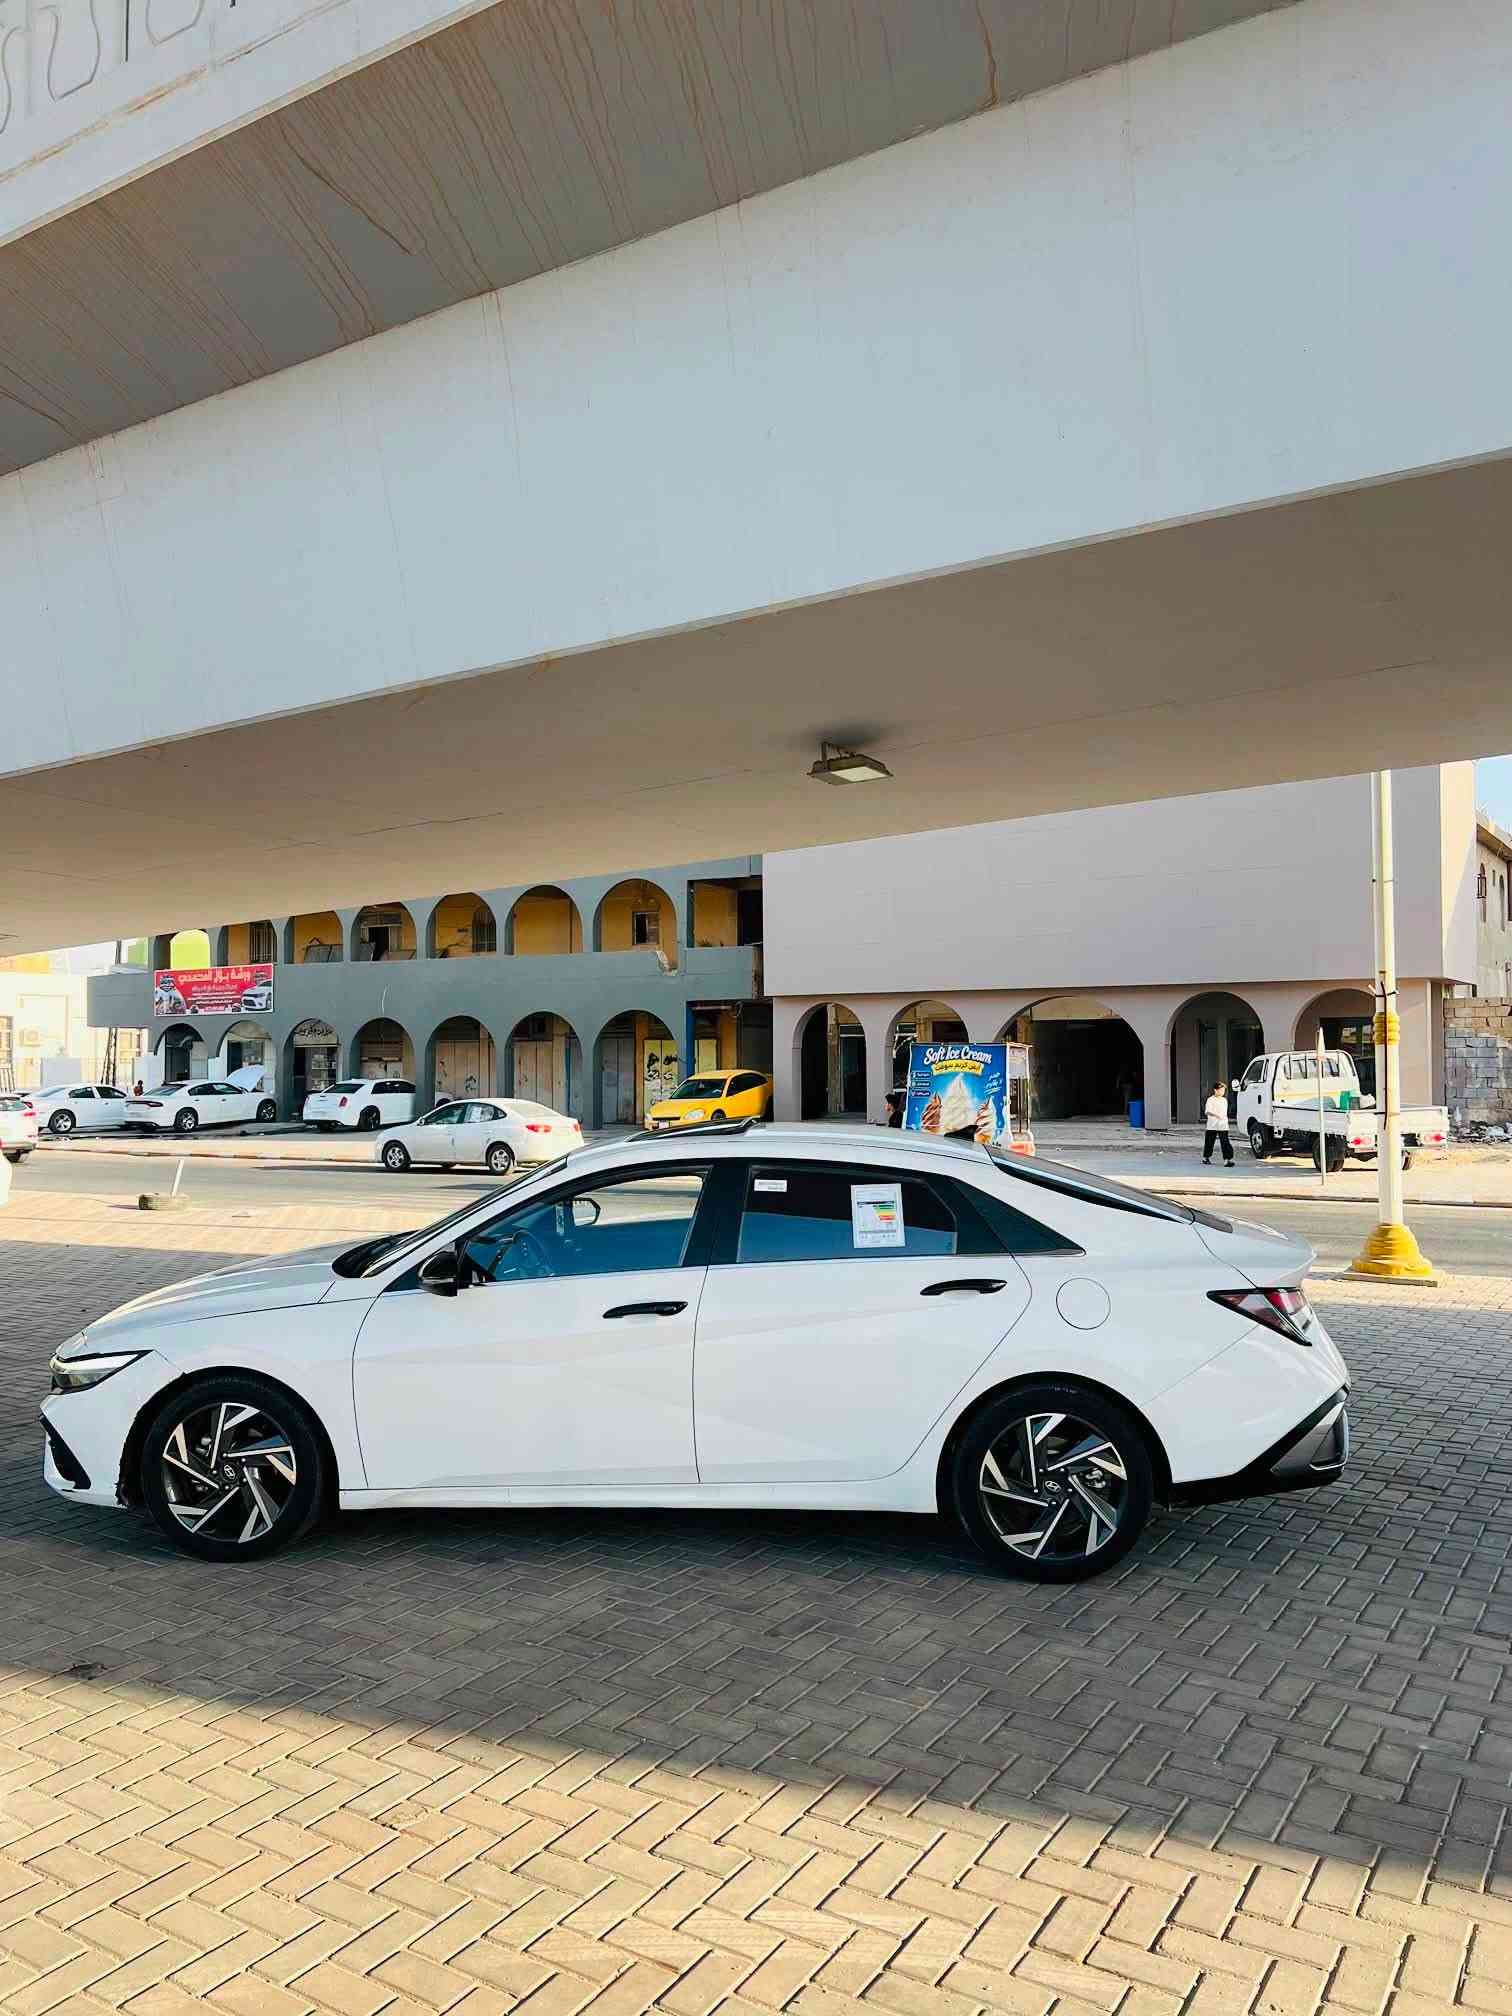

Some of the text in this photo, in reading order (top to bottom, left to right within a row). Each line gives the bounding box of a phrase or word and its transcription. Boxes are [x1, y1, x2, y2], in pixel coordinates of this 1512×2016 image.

[924, 1046, 992, 1064] Soft Ice Cream
